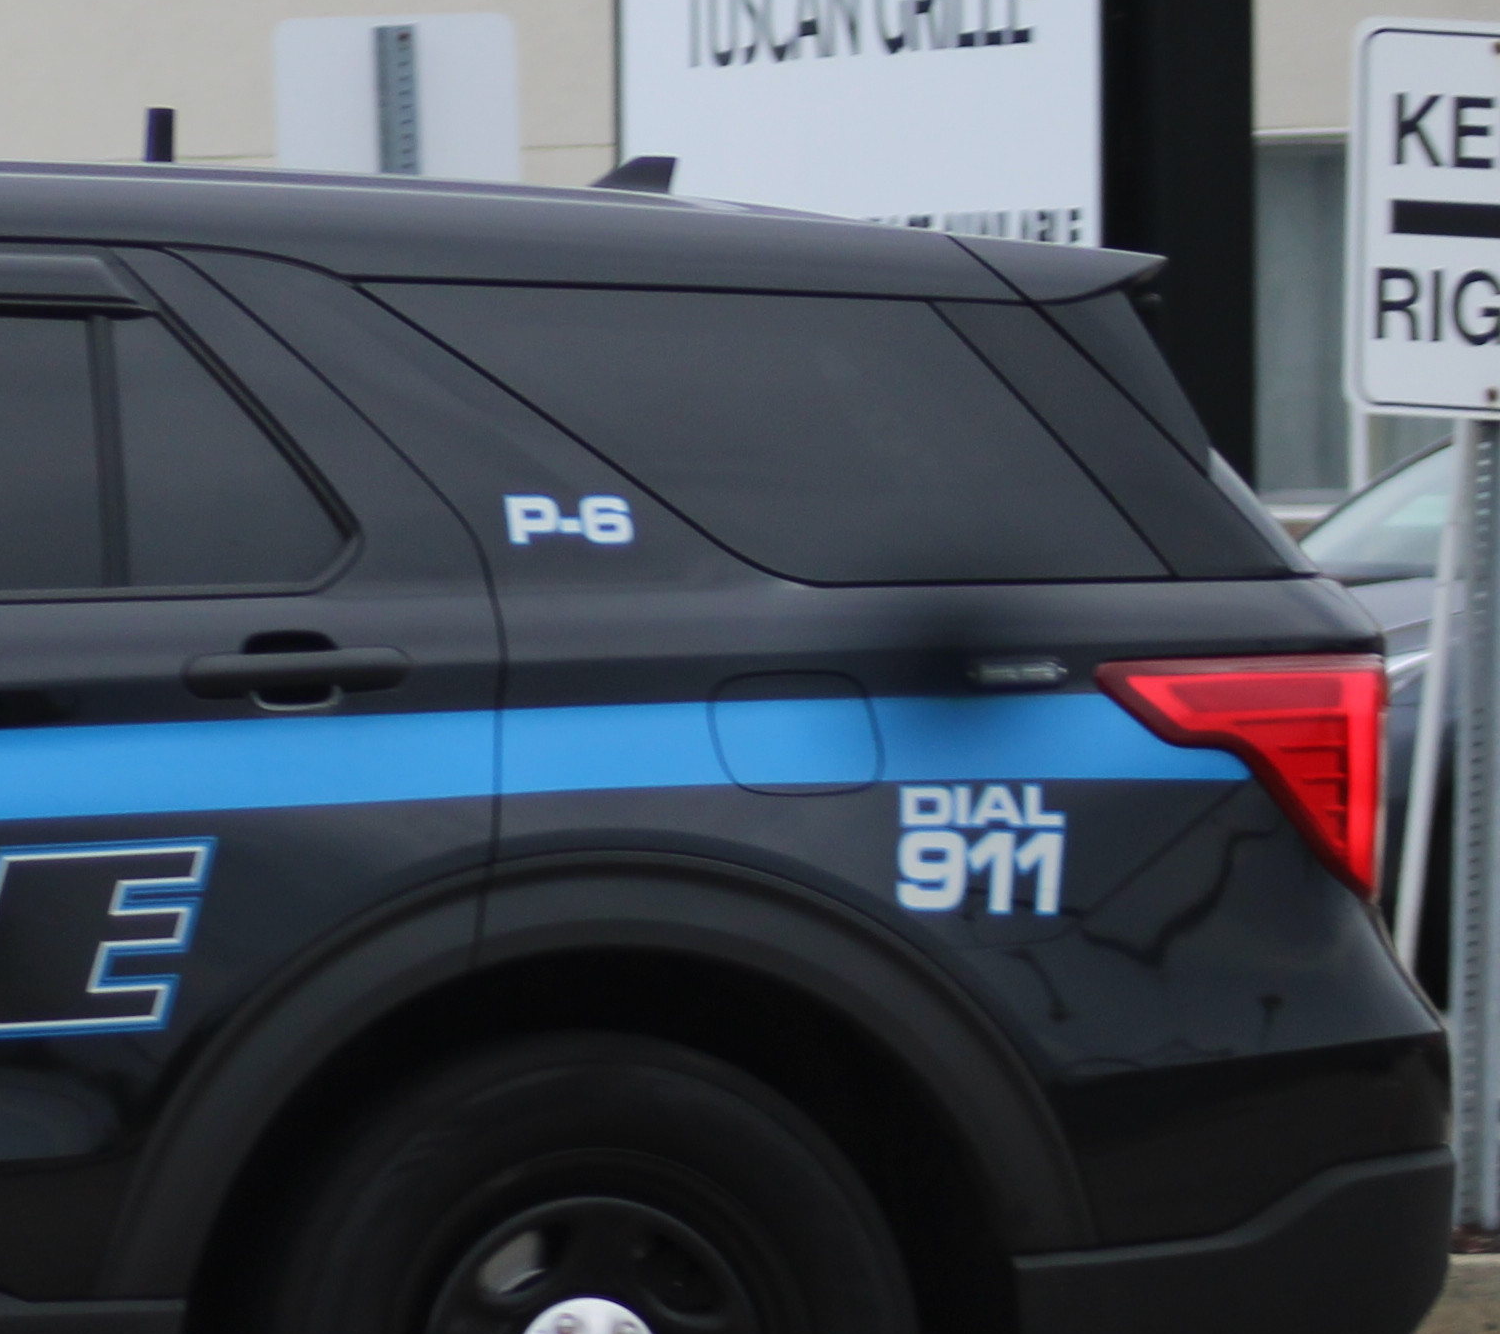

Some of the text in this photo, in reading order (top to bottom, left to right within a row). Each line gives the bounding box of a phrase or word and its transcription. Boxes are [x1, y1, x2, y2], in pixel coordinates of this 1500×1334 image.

[502, 494, 636, 545] P-6
[899, 783, 1067, 828] DIAL
[895, 828, 1065, 917] 911
